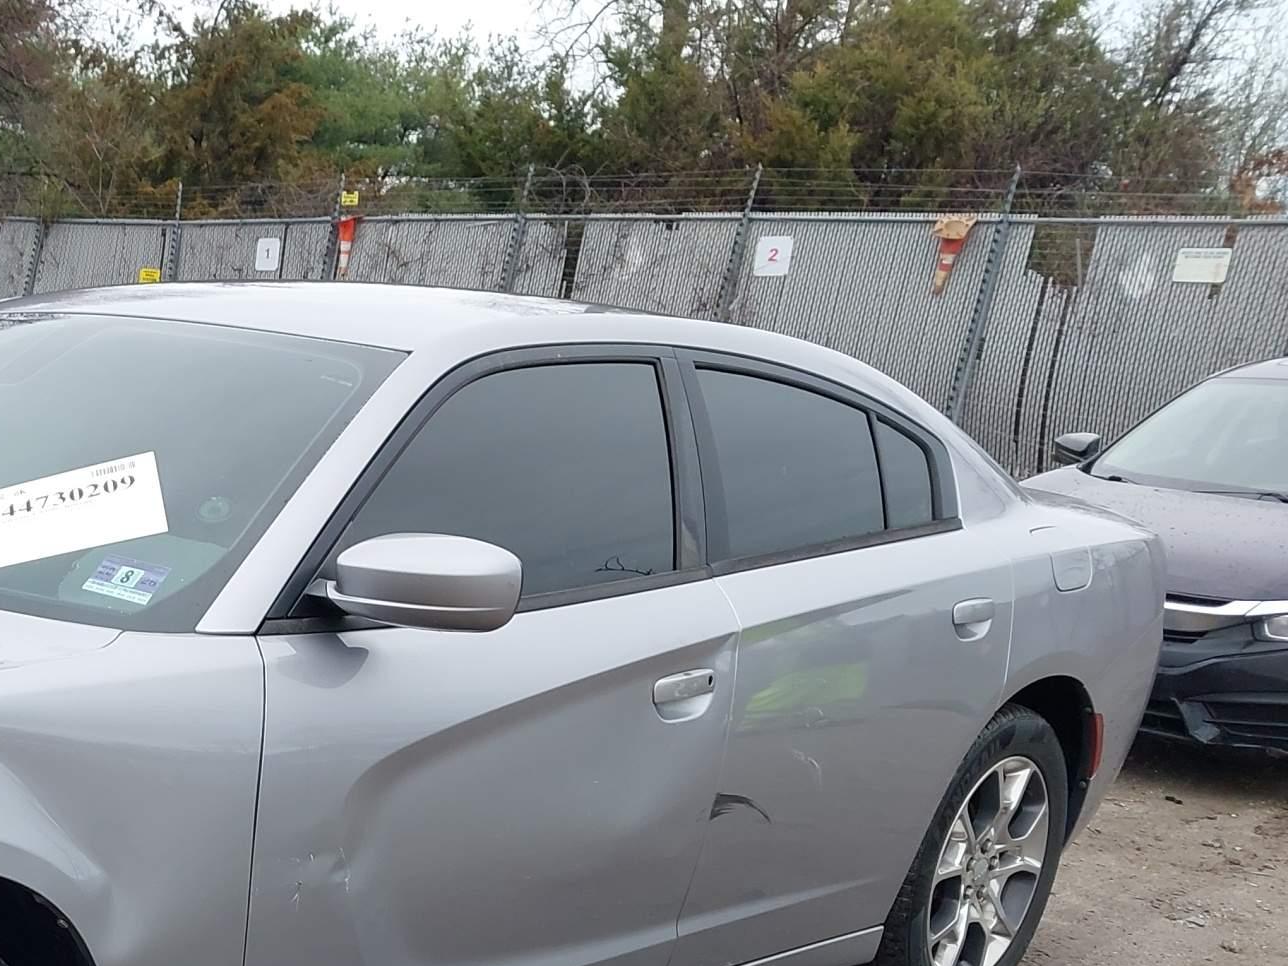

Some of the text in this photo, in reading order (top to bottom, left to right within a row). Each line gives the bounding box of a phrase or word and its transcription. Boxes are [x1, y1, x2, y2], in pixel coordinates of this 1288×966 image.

[767, 248, 779, 262] 2
[1, 474, 136, 517] 44730209
[119, 569, 135, 584] 8
